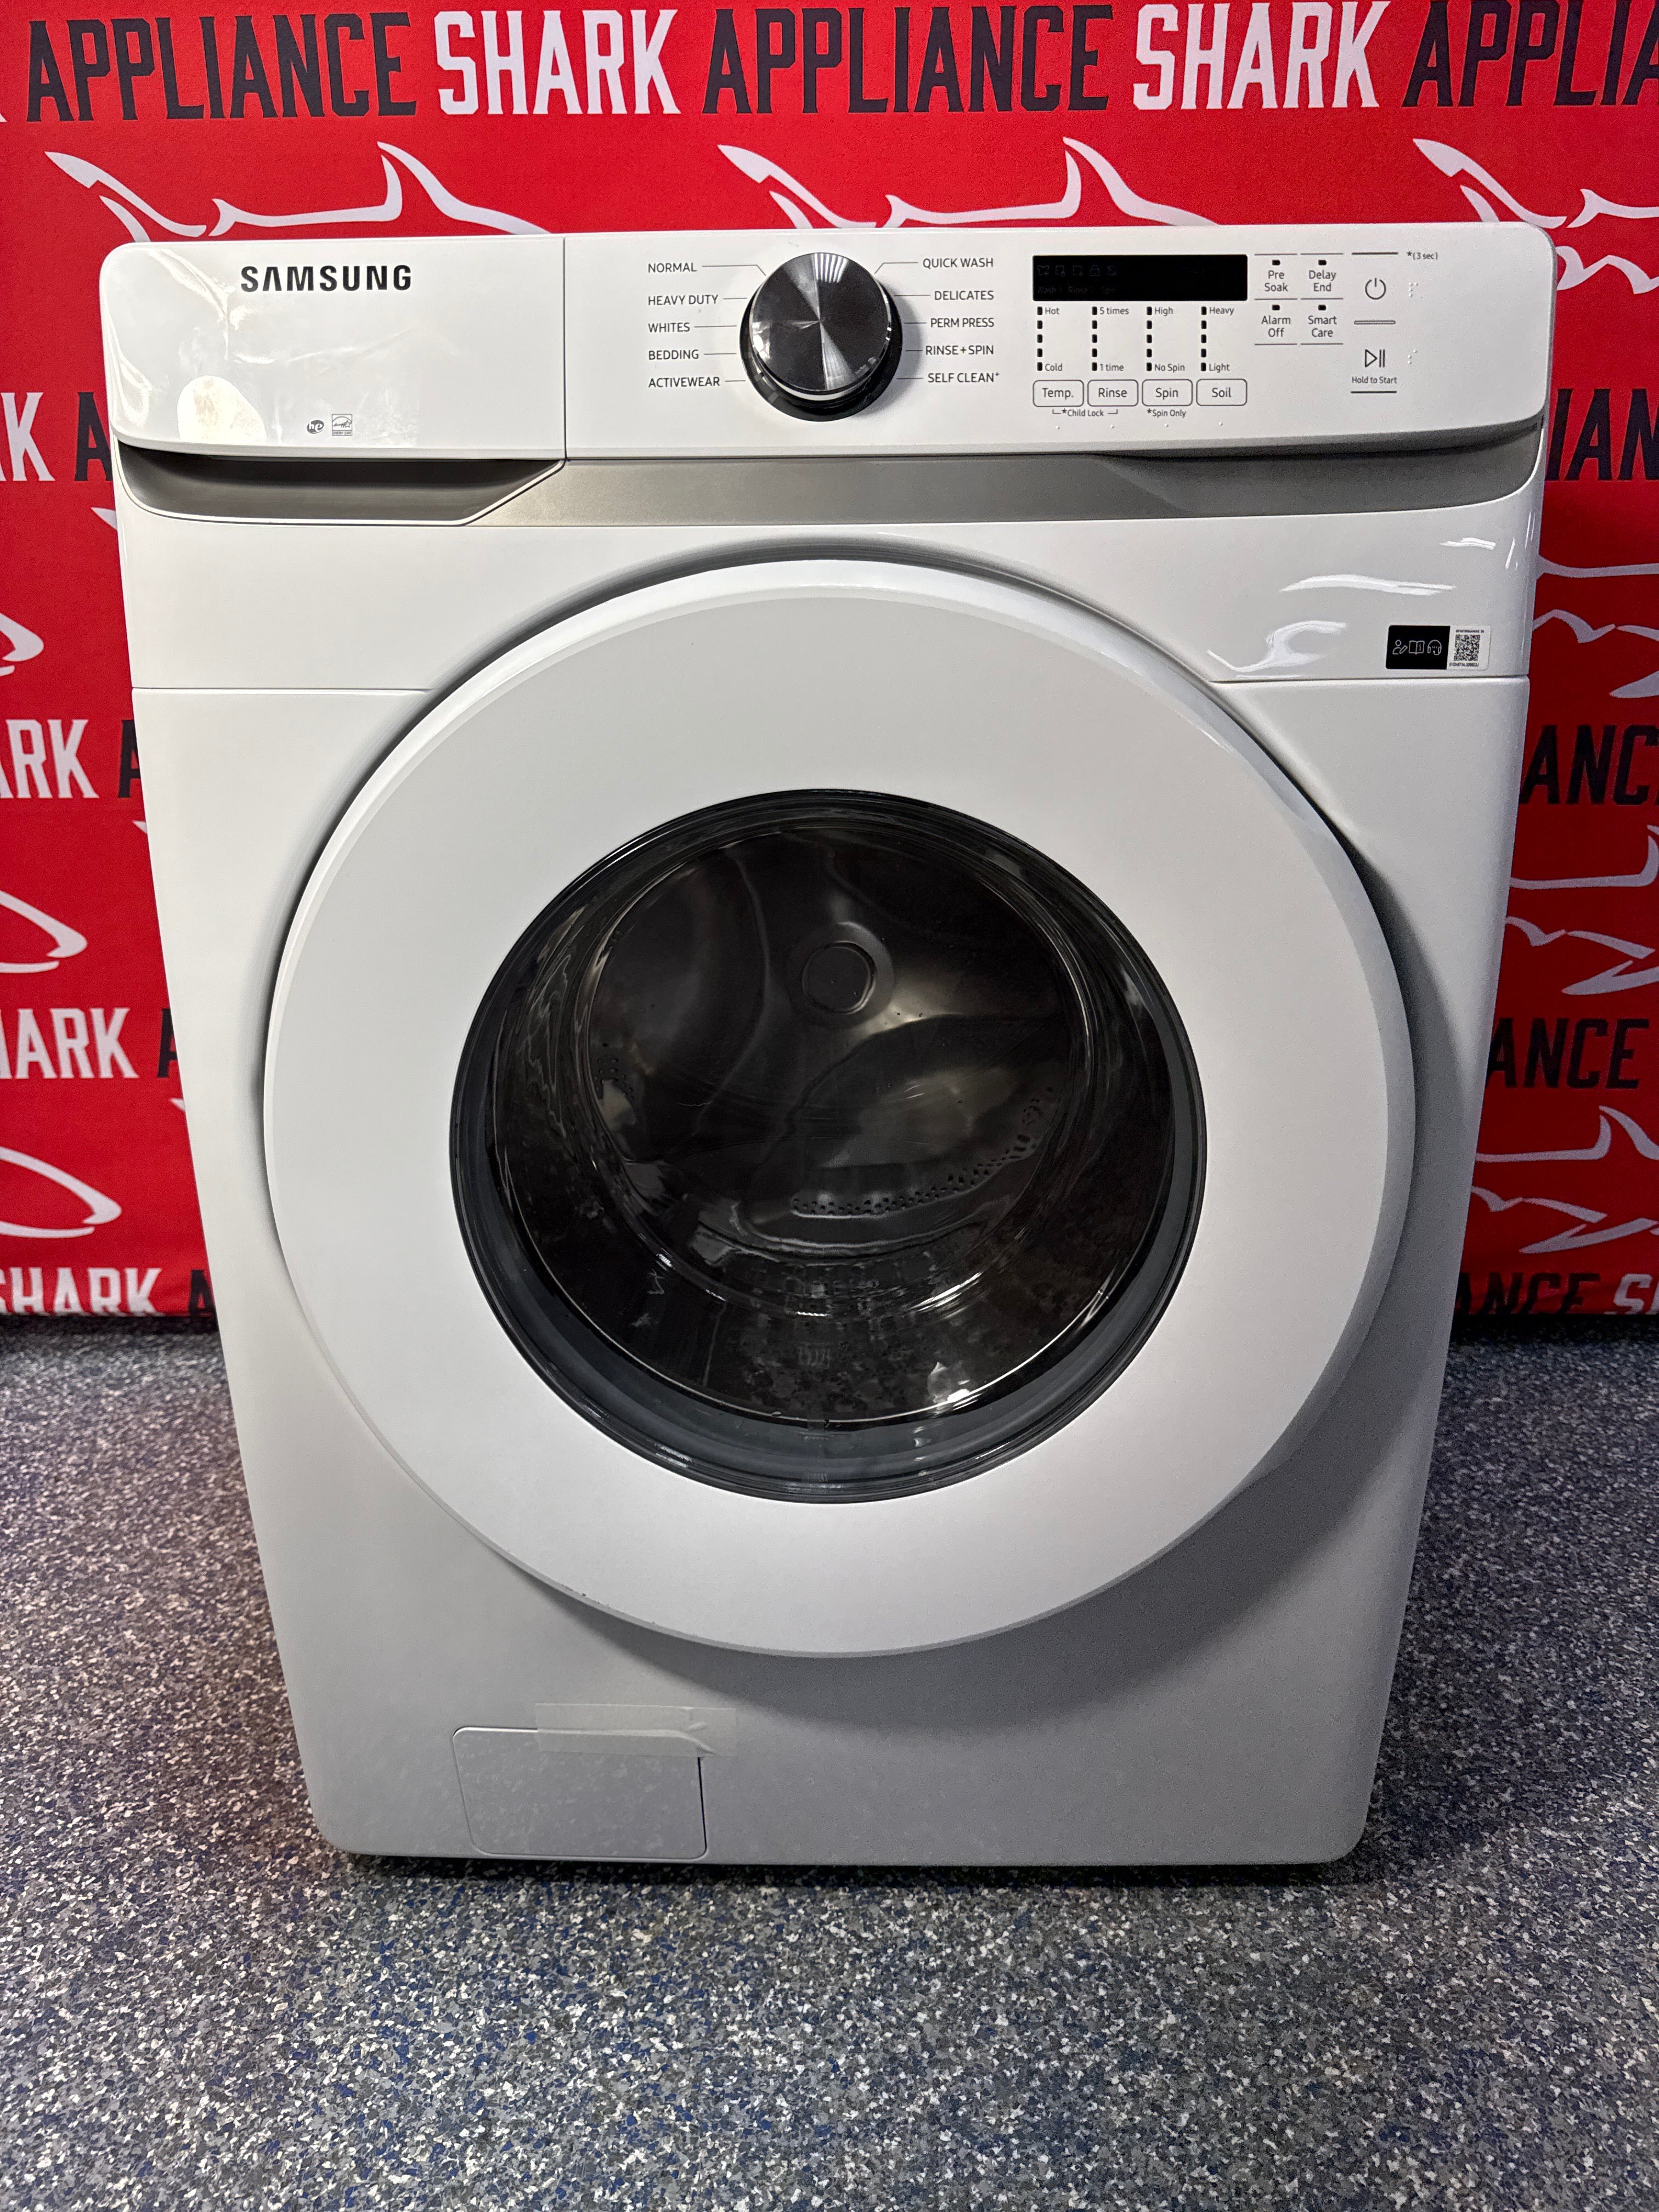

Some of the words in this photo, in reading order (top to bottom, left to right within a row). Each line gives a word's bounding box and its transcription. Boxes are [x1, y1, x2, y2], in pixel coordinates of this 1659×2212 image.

[26, 12, 416, 122] APPLIANCE
[434, 10, 680, 115] SHARK
[702, 4, 1109, 114] APPLIANCE
[1133, 1, 1391, 110] SHARK
[648, 262, 697, 273] NORMAL
[922, 258, 958, 270] QUICK
[960, 257, 994, 268] WASH
[241, 265, 411, 292] SAMSUNG
[1268, 270, 1285, 279] Pre
[1308, 269, 1337, 281] Delay
[1264, 282, 1288, 292] Soak
[1313, 282, 1332, 292] End
[648, 295, 686, 306] HEAVY
[689, 294, 719, 305] DUTY
[934, 290, 994, 301] DELICATES
[1045, 307, 1060, 315] Hot
[1099, 307, 1105, 315] 5
[1154, 307, 1173, 317] High
[1209, 307, 1234, 316] Heavy
[930, 318, 960, 328] PERM
[962, 317, 995, 328] PRESS
[1261, 315, 1291, 325] Alarm
[1307, 315, 1337, 325] Smart
[647, 322, 690, 333] WHITES
[1268, 328, 1285, 337] Off
[1311, 328, 1334, 337] Care
[648, 349, 699, 360] BEDDING
[1045, 363, 1063, 371] Cold
[1099, 363, 1103, 371] 1
[1167, 363, 1185, 374] Spin
[1209, 363, 1230, 374] Light
[648, 376, 720, 388] ACTIVEWEAR
[928, 373, 955, 383] SELF
[1351, 376, 1369, 384] Hold
[1379, 376, 1397, 384] Start
[1042, 387, 1074, 400] Temp.
[1098, 387, 1127, 398] Rinse
[1155, 387, 1178, 400] Spin
[1212, 387, 1232, 398] Soil
[1169, 409, 1187, 419] Only
[1519, 725, 1659, 805] ANC
